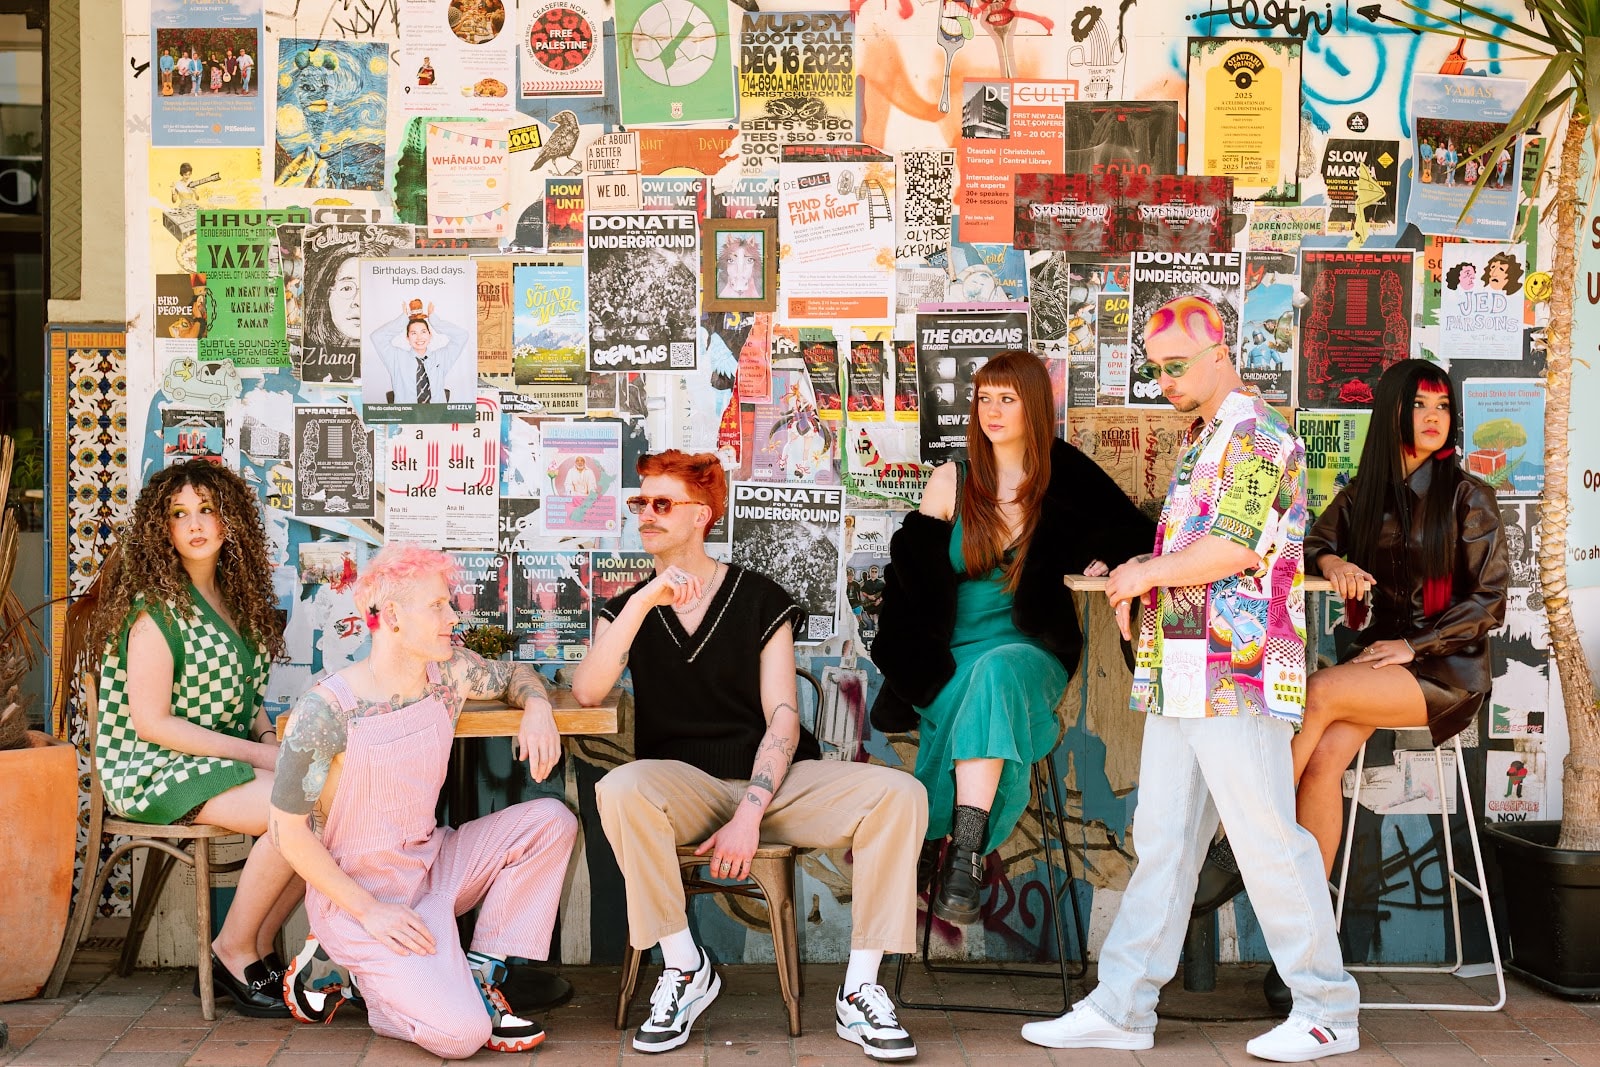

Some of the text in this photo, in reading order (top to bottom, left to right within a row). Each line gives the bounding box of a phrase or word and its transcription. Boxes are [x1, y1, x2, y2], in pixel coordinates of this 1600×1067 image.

[531, 1, 588, 19] CEASEFIRE NOW
[742, 14, 852, 32] MUDDY
[549, 29, 573, 38] FREE
[741, 33, 853, 45] BOOT SALE
[536, 41, 588, 50] PALESTINE
[741, 46, 853, 74] DEC 16 2023
[786, 75, 839, 92] HAREWOOD
[842, 75, 853, 92] RD
[985, 86, 1009, 102] DE
[1234, 92, 1253, 100] 2025
[741, 119, 853, 131] BELTS $180
[609, 134, 631, 145] ABOUT
[742, 132, 853, 143] TEES $50 $70
[596, 147, 621, 157] BETTER
[1003, 147, 1045, 155] Christchurch
[1327, 150, 1367, 163] SLOW
[432, 155, 503, 166] WHĀNAU DAY
[589, 159, 619, 170] FUTURE?
[1028, 158, 1052, 166] Library
[800, 173, 829, 188] CULT
[550, 185, 582, 196] HOW
[597, 185, 611, 198] WE
[668, 182, 703, 192] LONG
[676, 196, 696, 206] WE
[722, 196, 756, 206] UNTIL
[788, 198, 821, 213] FUND
[790, 203, 859, 225] FILM NIGHT
[589, 216, 694, 231] DONATE
[1252, 221, 1322, 231] ADRENOCHROME
[588, 235, 695, 249] UNDERGROUND
[1271, 233, 1302, 241] BABIES
[1137, 252, 1240, 268] DONATE
[372, 266, 465, 276] Birthdays. Bad days.
[392, 276, 446, 286] Hump days.
[1135, 269, 1240, 286] UNDERGROUND
[157, 296, 178, 305] BIRD
[526, 286, 572, 308] SOUND
[1458, 292, 1507, 316] JED
[157, 306, 193, 316] PEOPLE
[536, 299, 581, 327] MUSIC
[1446, 315, 1519, 333] PARSONS
[922, 328, 1023, 345] THE GROGANS
[303, 347, 356, 381] Zhang
[1518, 390, 1541, 398] Climate
[552, 400, 579, 408] ARCADE
[938, 415, 961, 426] NEW
[472, 427, 480, 438] a
[1300, 420, 1340, 436] BRANT
[415, 429, 423, 440] a
[1101, 431, 1130, 440] RELICS
[391, 457, 418, 471] salt
[448, 456, 475, 470] salt
[406, 483, 437, 498] lake
[463, 482, 493, 496] lake
[736, 487, 840, 504] DONATE
[735, 506, 840, 523] UNDERGROUND
[469, 557, 504, 568] LONG
[517, 555, 549, 566] HOW
[597, 558, 628, 569] HOW
[478, 571, 498, 582] WE
[523, 569, 557, 579] UNTIL
[603, 571, 637, 582] UNTIL
[454, 583, 485, 594] ACT?
[536, 583, 567, 593] ACT?
[1489, 800, 1540, 812] CEASEFIRE
[1497, 813, 1527, 822] NOW
